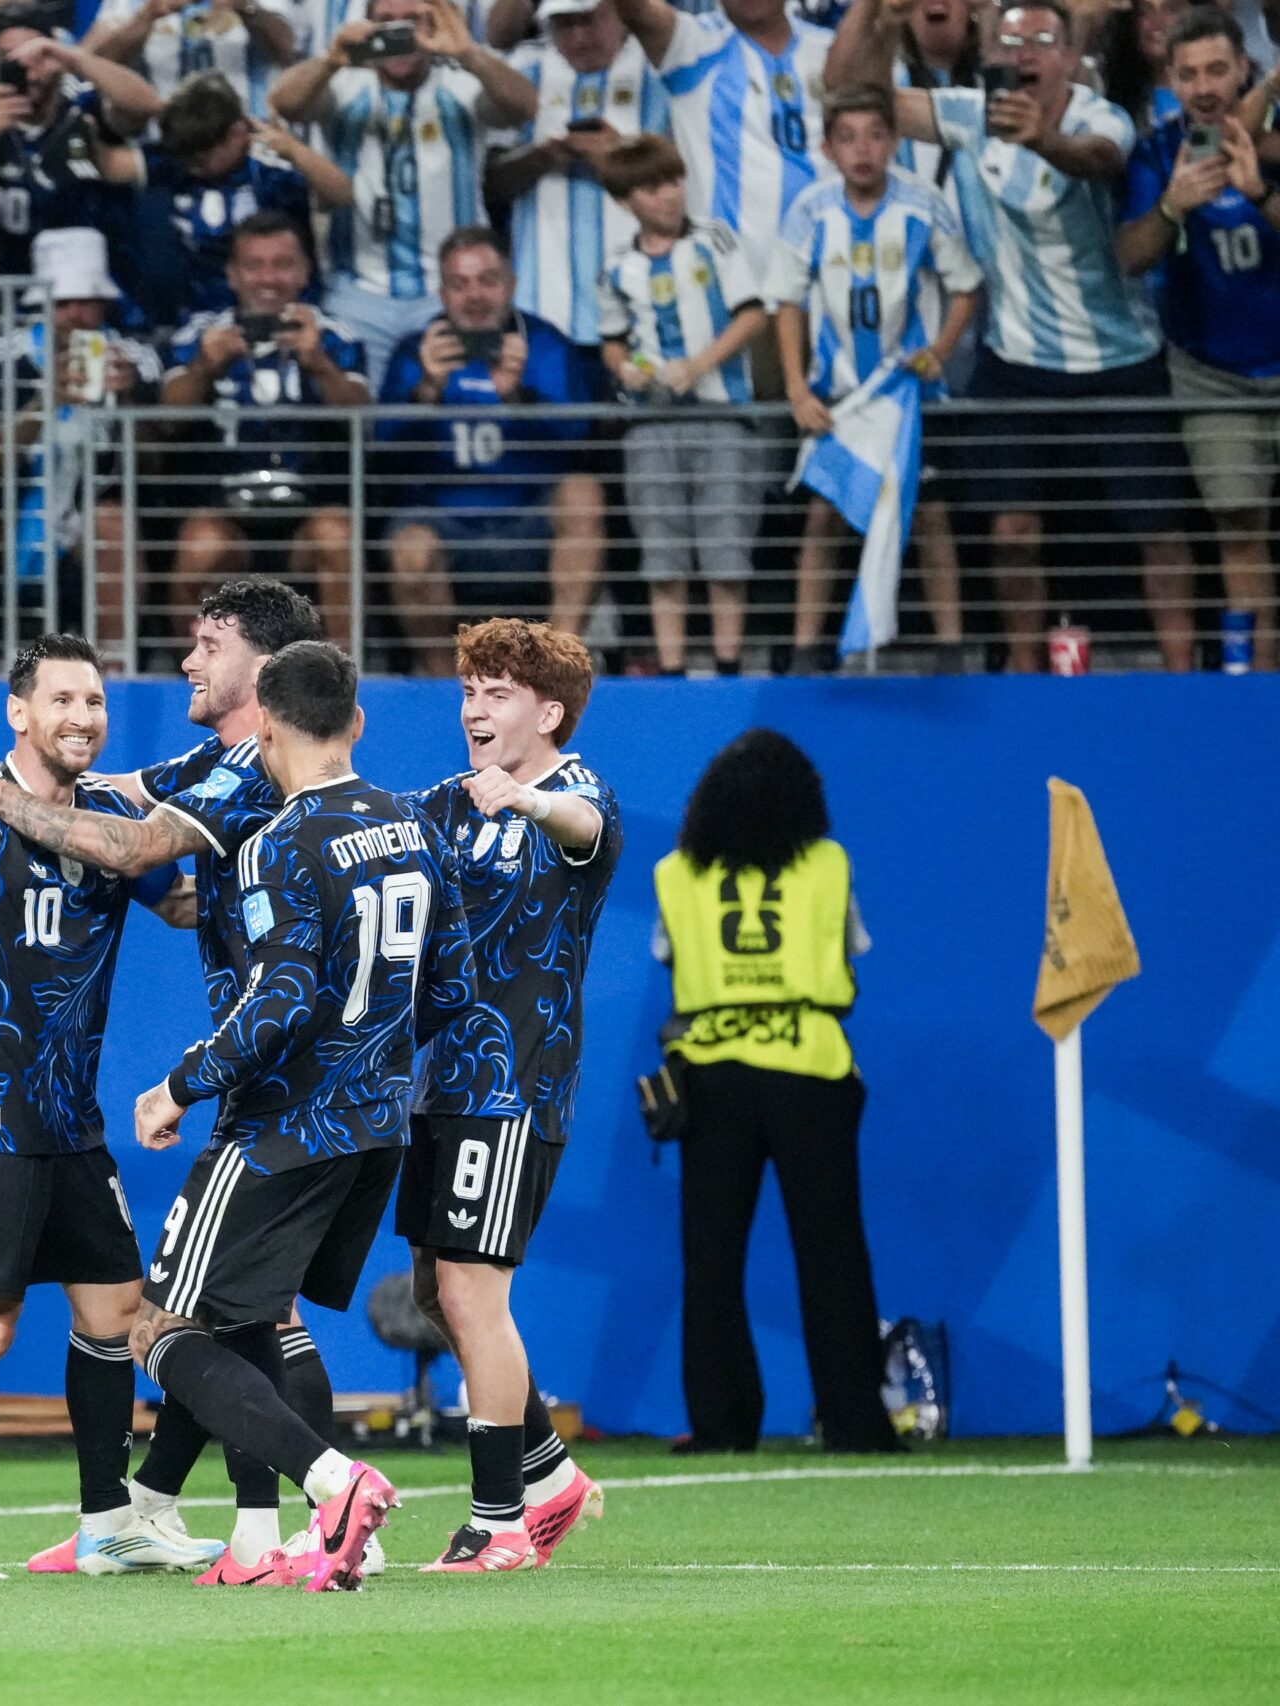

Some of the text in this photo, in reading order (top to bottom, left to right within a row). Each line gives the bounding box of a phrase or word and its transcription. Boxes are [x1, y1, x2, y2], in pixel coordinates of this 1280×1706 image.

[1211, 223, 1260, 273] 10
[850, 286, 879, 331] 10
[452, 422, 502, 468] 10
[330, 820, 429, 870] OTAMENDI
[23, 887, 64, 947] 10
[342, 871, 432, 1026] 19
[452, 1139, 491, 1201] 8
[163, 1195, 189, 1257] 9
